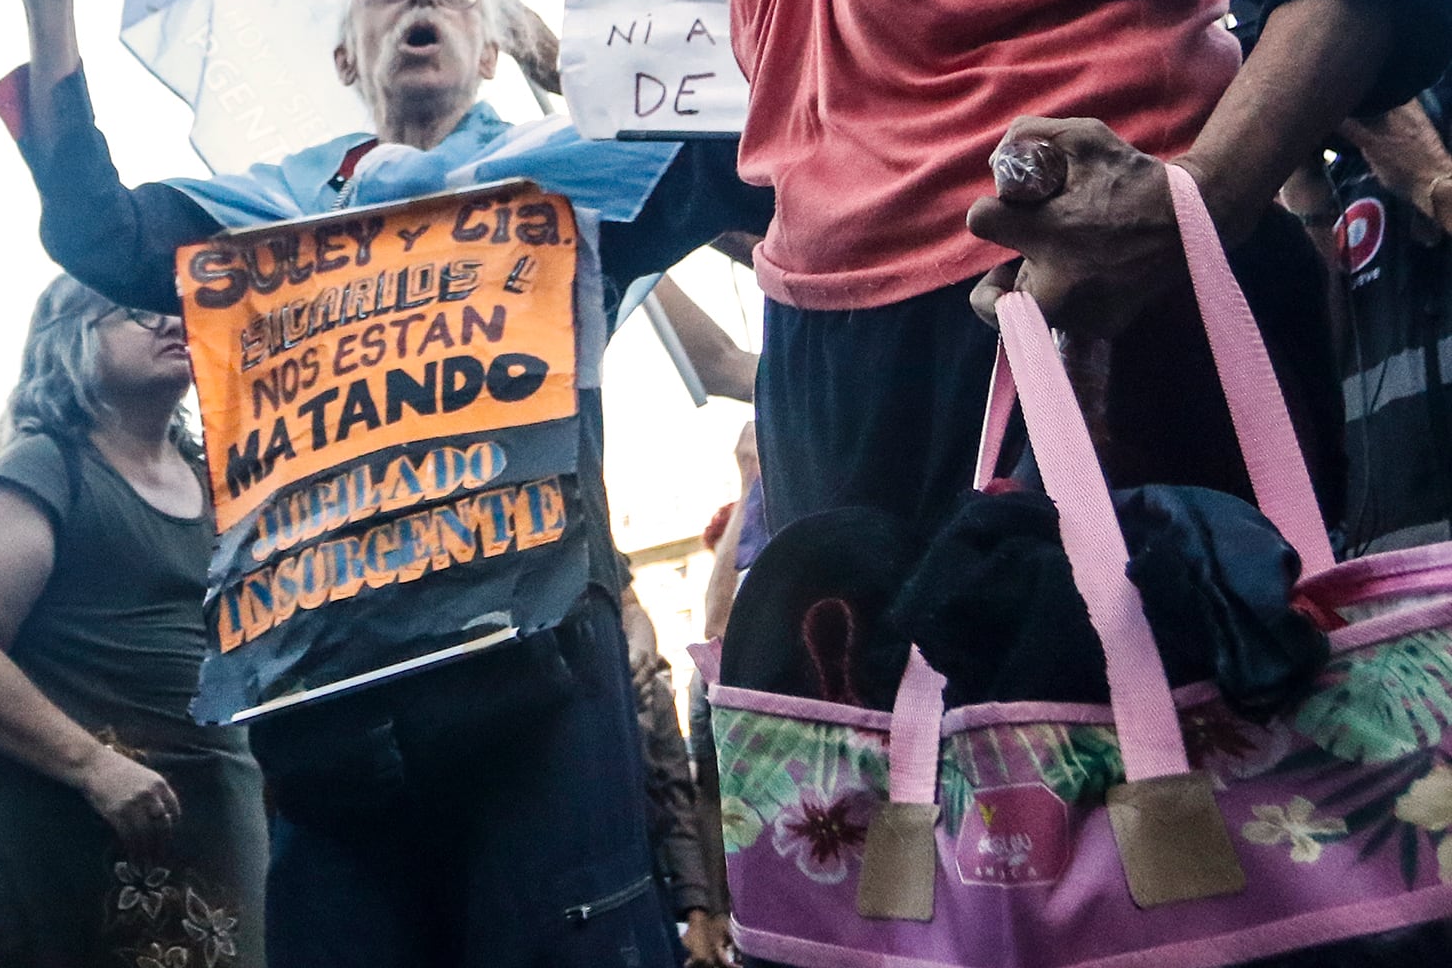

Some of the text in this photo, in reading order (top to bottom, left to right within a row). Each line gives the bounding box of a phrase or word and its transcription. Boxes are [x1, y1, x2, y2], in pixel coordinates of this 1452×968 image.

[635, 72, 715, 116] DE
[251, 305, 507, 420] NOS ESTAN
[225, 352, 550, 499] MATANDO
[252, 440, 507, 561] JUBILADO
[218, 474, 566, 653] INSURGENTE
